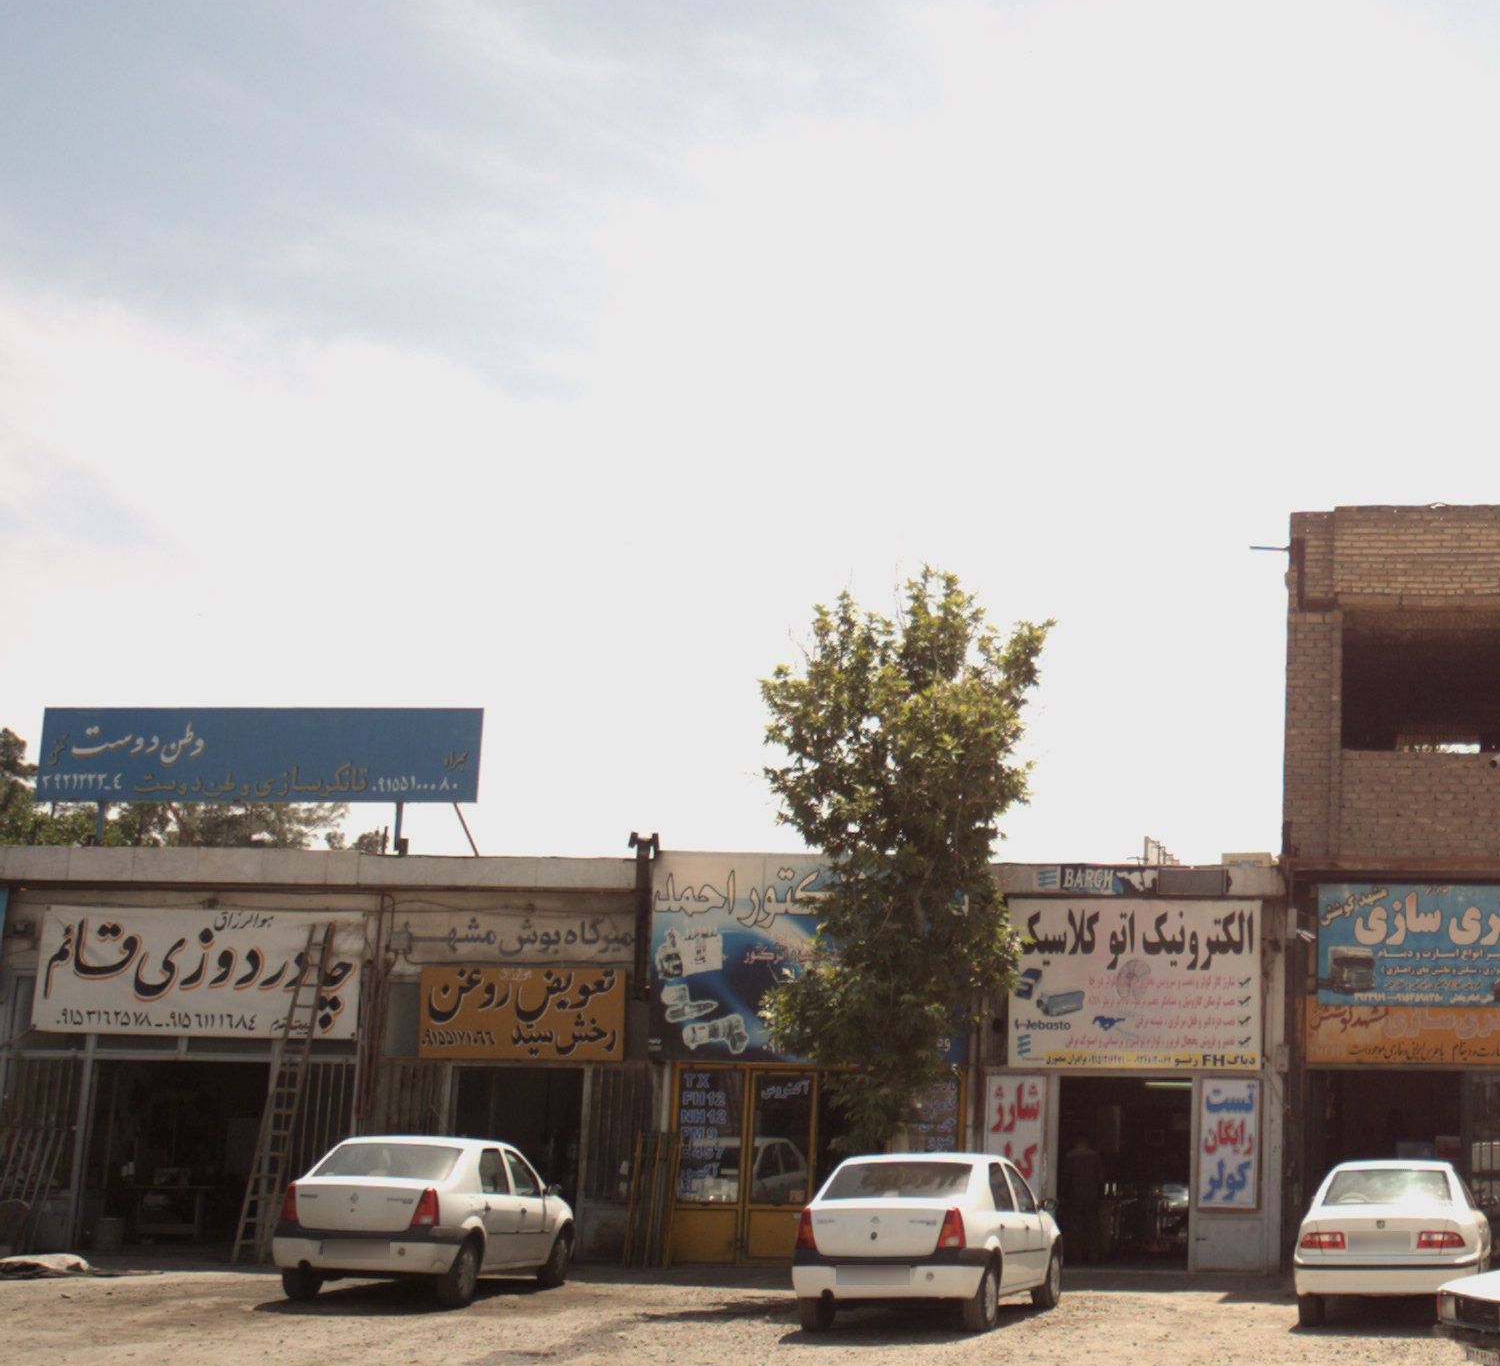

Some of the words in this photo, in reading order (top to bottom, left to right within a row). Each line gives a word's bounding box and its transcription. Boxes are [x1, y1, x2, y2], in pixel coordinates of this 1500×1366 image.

[653, 869, 737, 918] احمد
[1063, 868, 1116, 894] BARGH
[1021, 908, 1100, 968] کلاسیک
[1105, 909, 1136, 971] اتو
[1141, 910, 1254, 972] الکترونیک
[1352, 890, 1442, 947] سازی
[427, 967, 513, 1025] روغن
[515, 967, 619, 1024] تعویض
[990, 1082, 1041, 1133] شارژ
[1204, 1084, 1255, 1114] تست
[1203, 1118, 1255, 1156] رایگان
[1202, 1158, 1253, 1202] کولر
